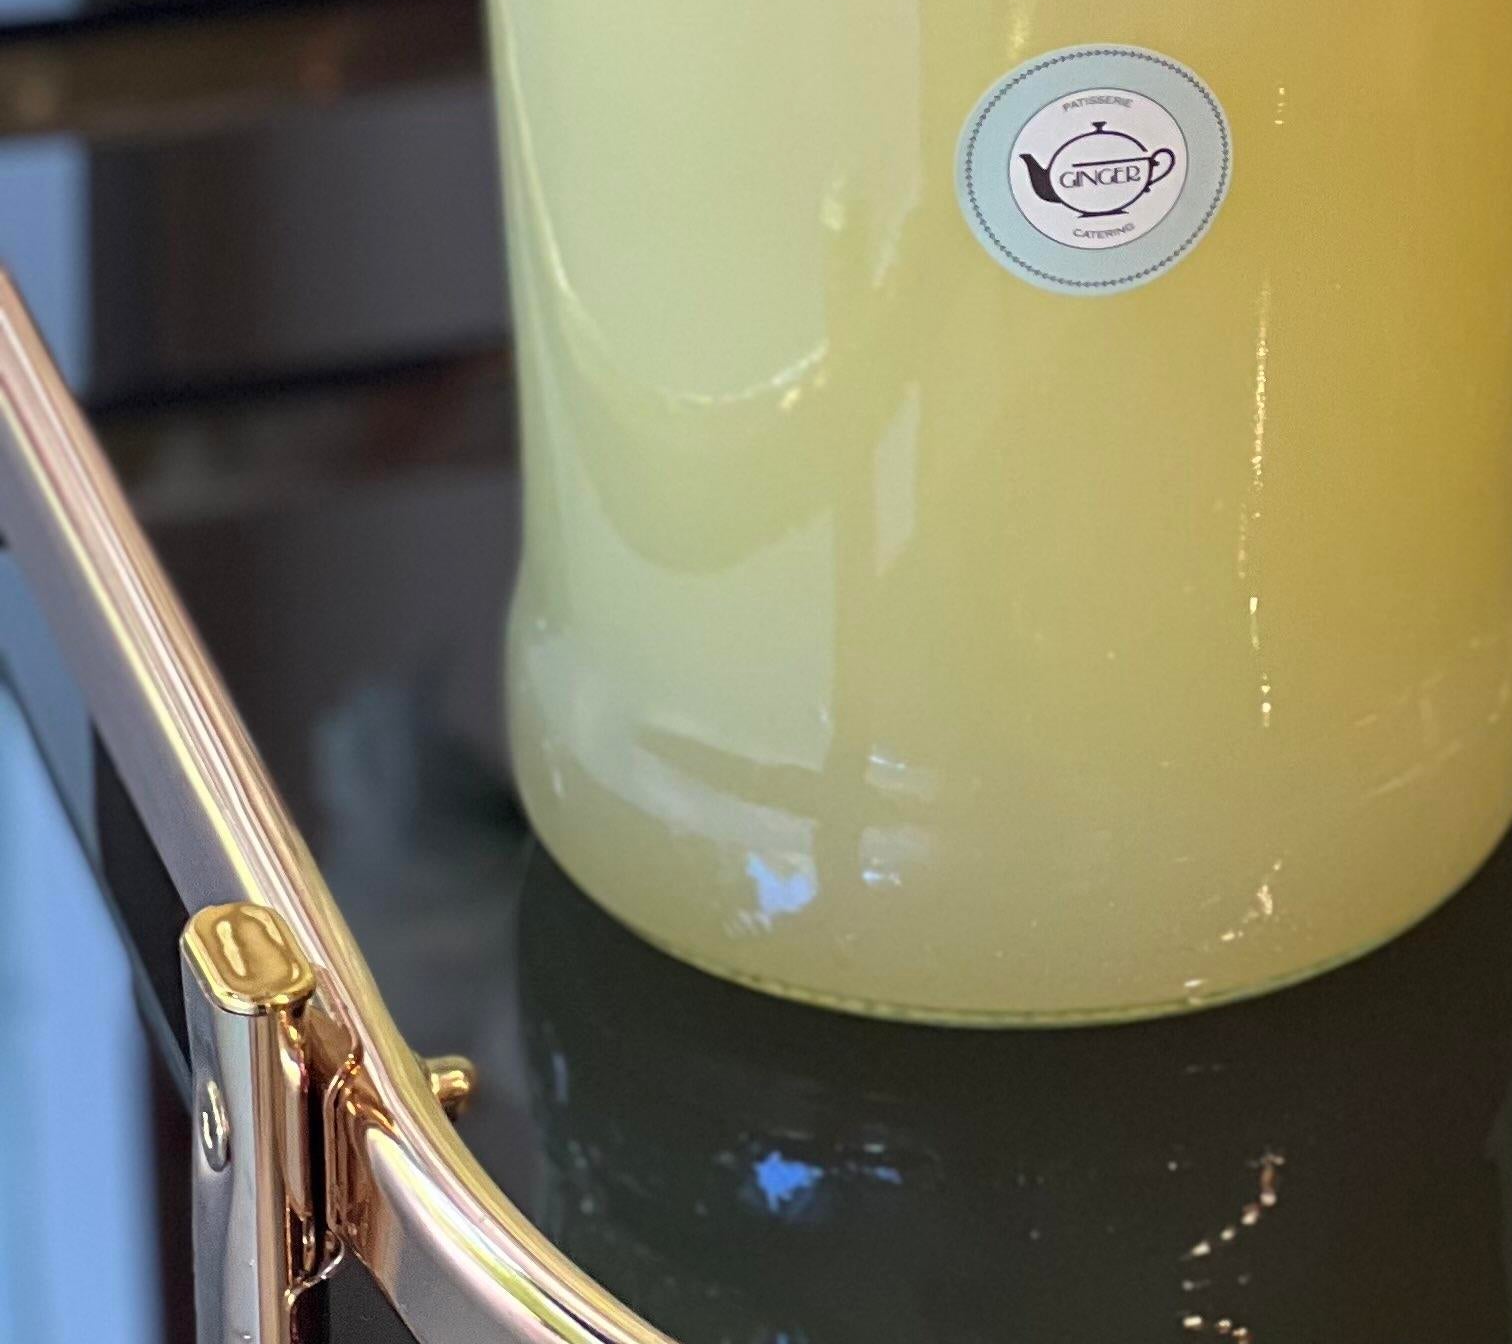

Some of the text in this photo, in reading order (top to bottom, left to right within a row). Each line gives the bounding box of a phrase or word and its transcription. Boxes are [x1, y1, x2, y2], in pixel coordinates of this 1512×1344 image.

[1062, 95, 1134, 112] PATISSERIE
[1060, 165, 1141, 189] GINGER
[1072, 223, 1135, 239] CATERING
